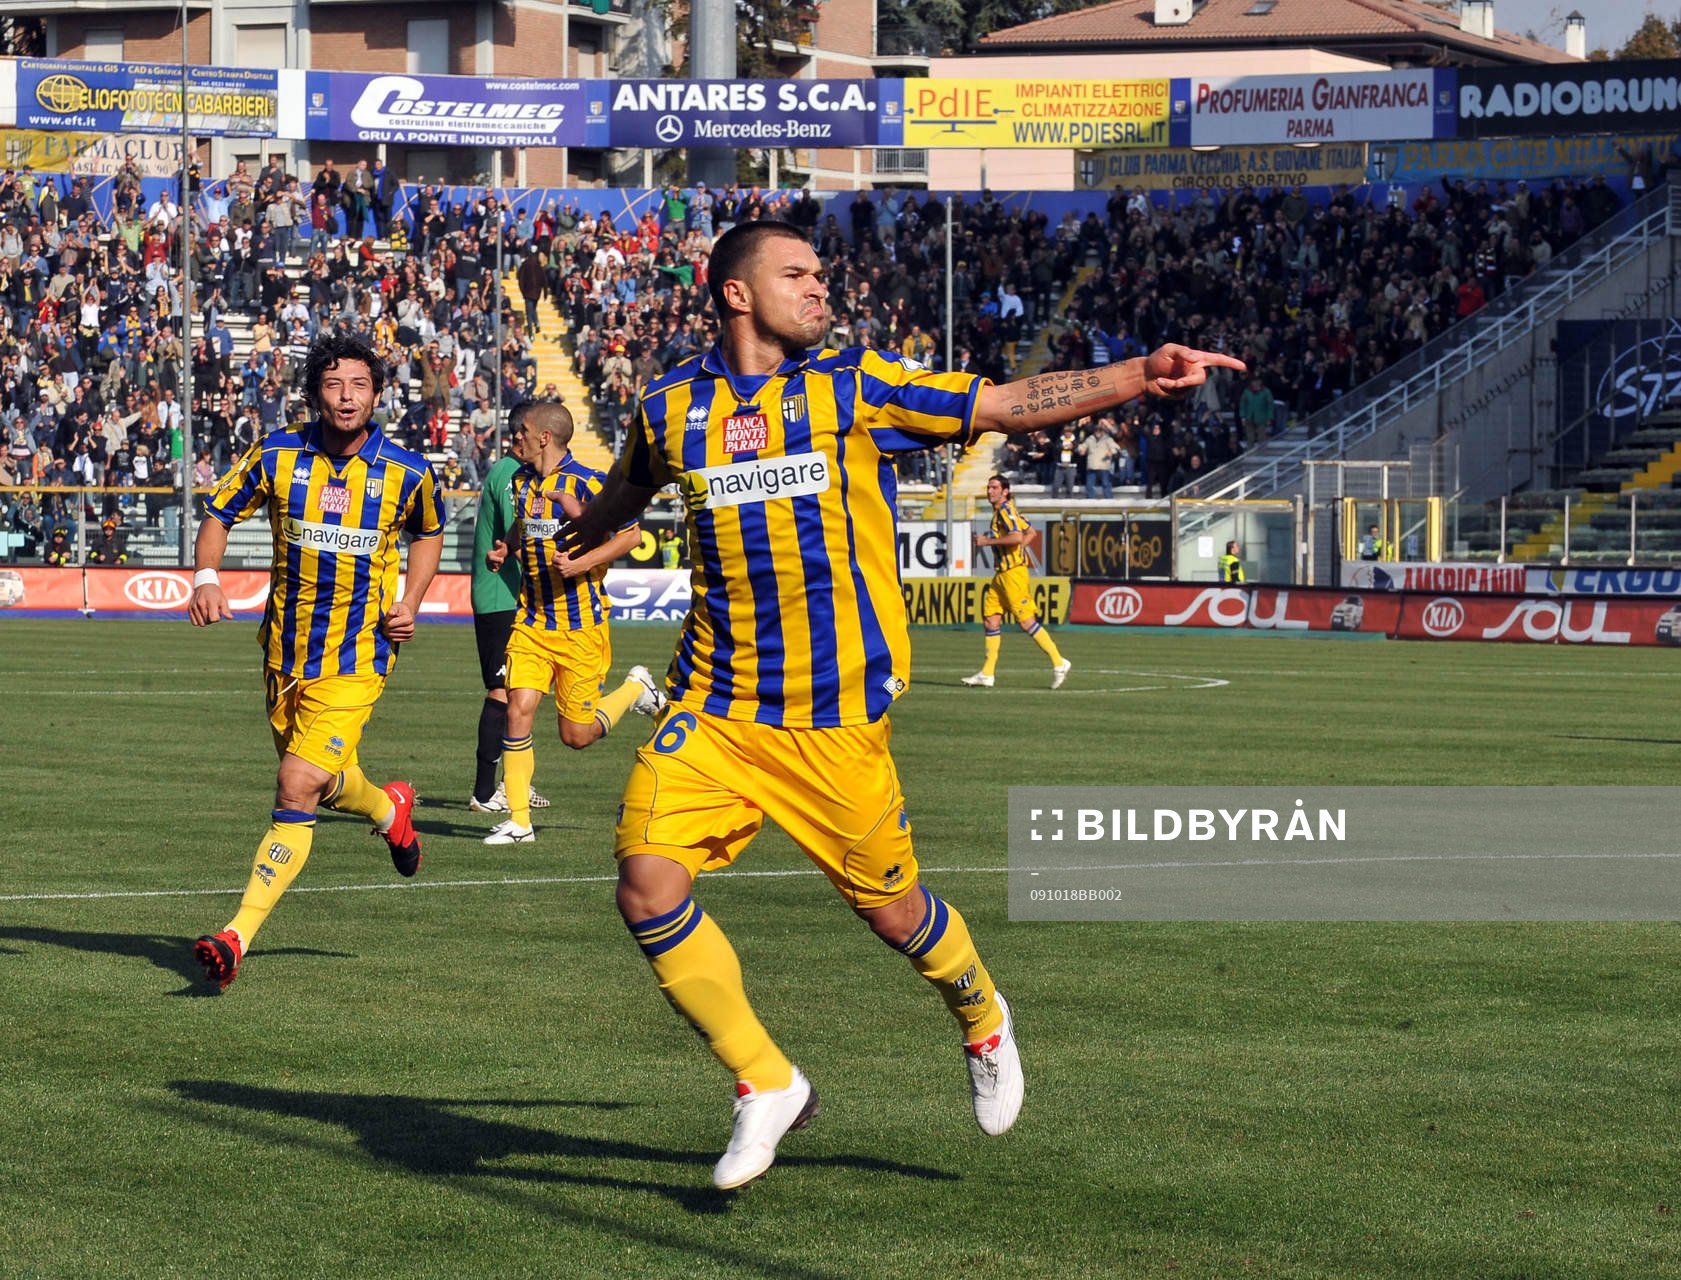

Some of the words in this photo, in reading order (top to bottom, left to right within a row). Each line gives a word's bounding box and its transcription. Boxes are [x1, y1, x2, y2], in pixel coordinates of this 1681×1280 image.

[104, 64, 118, 73] GIS
[128, 65, 146, 74] CAD
[485, 81, 580, 91] www.costelmec.com
[1015, 83, 1087, 99] IMPIANTI
[1092, 82, 1169, 98] ELETTRICI
[612, 83, 766, 112] ANTARES
[777, 83, 877, 112] S.C.A.
[1195, 83, 1305, 114] PROFUMERIA
[1311, 78, 1429, 111] GIANFRANCA
[1459, 76, 1681, 119] RADIOBRUN
[1021, 102, 1163, 118] CLIMATIZZAZIONE
[29, 114, 96, 127] www.eft.it
[388, 118, 445, 128] costruzioni
[694, 119, 832, 139] Mercedes-Benz
[1286, 118, 1335, 138] PARMA
[358, 130, 391, 141] GRU
[394, 132, 407, 142] A
[408, 132, 457, 144] PONTE
[460, 134, 557, 146] INDUSTRIALI
[1012, 121, 1167, 144] WWW.PDIESRL.IT
[1403, 139, 1487, 171] PARMA
[1490, 137, 1548, 170] CLUB
[1109, 154, 1140, 177] CLUB
[1144, 153, 1189, 176] PARMA
[1172, 174, 1233, 189] CIRCOLO
[1237, 172, 1308, 187] SPORTIVO
[727, 416, 766, 430] BANCA
[724, 427, 767, 442] MONTE
[725, 438, 766, 453] PARMA
[709, 461, 825, 496] navigare
[320, 495, 351, 506] MONTE
[322, 486, 350, 498] BANCA
[319, 502, 349, 514] PARMA
[302, 527, 378, 550] navigare
[136, 579, 182, 601] KIA
[605, 572, 692, 607] GA
[904, 582, 975, 624] RANKIE
[1103, 595, 1135, 616] KIA
[1164, 587, 1309, 631] SOUL
[615, 608, 690, 621] JEAN
[1428, 605, 1458, 627] KIA
[1482, 599, 1632, 643] SOUL
